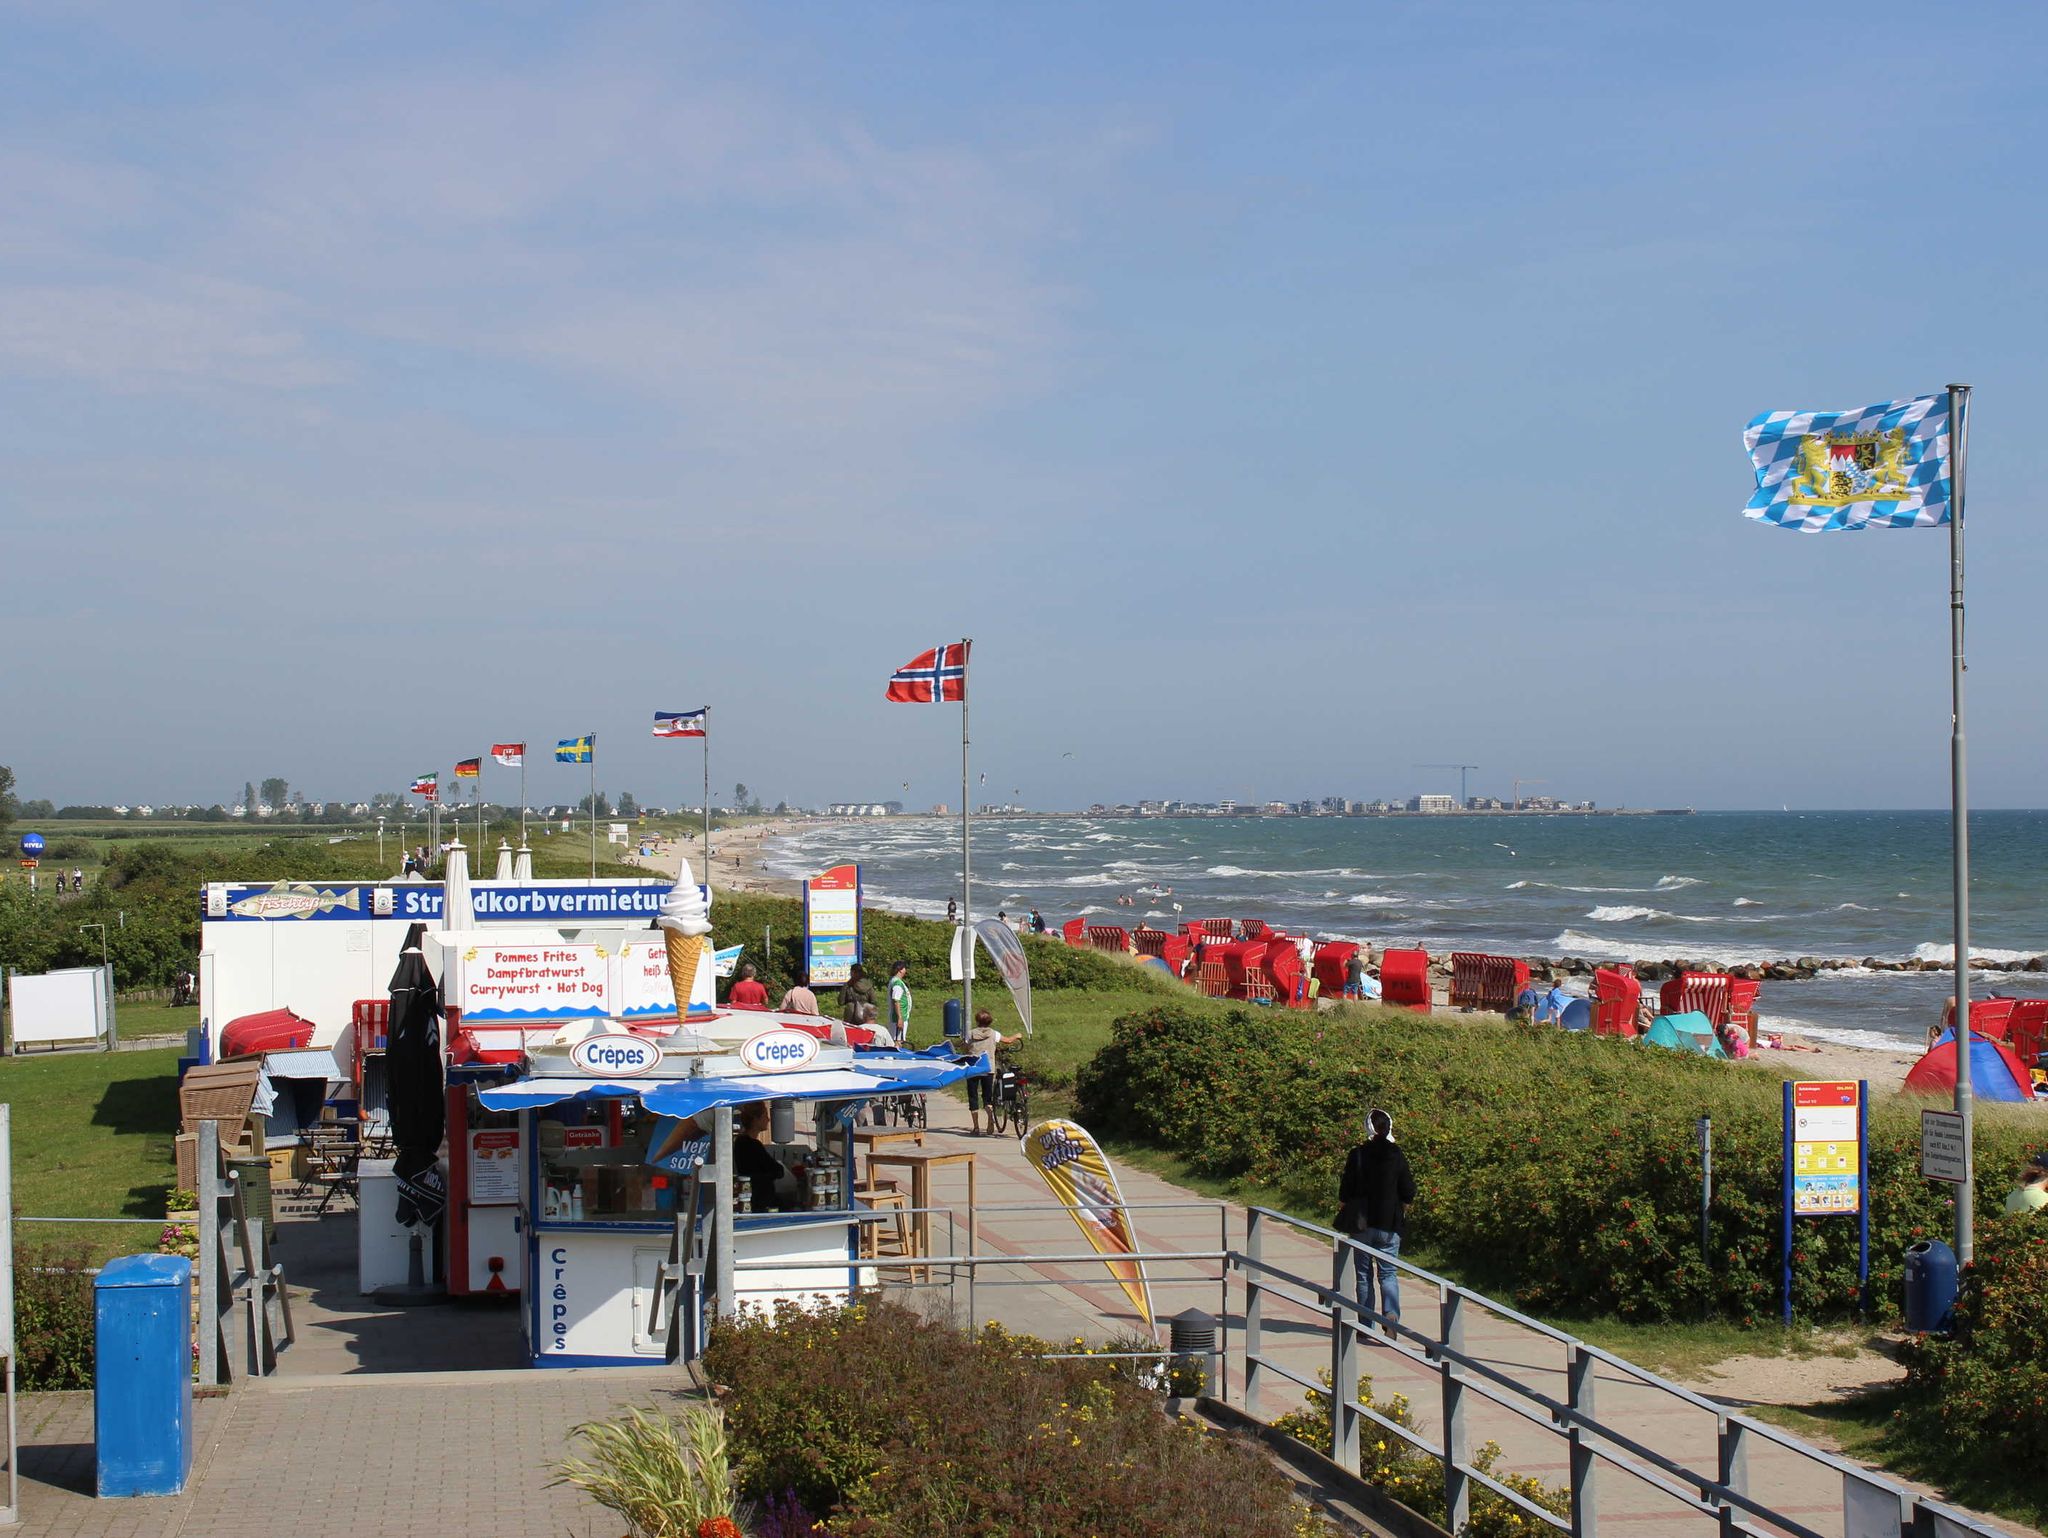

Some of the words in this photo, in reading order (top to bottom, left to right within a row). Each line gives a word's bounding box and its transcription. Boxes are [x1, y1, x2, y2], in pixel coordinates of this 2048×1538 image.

[495, 951, 539, 964] Pommes
[543, 950, 578, 963] Frites
[647, 947, 669, 960] Getr
[487, 966, 586, 984] Dampfbratwurst
[643, 964, 661, 978] heiß
[470, 984, 541, 999] Currywurst
[557, 982, 579, 994] Hot
[582, 981, 604, 998] Dog
[587, 1044, 645, 1069] Crêpes
[755, 1041, 805, 1066] Crêpes
[670, 1154, 696, 1170] sof
[551, 1248, 567, 1350] Crêpes
